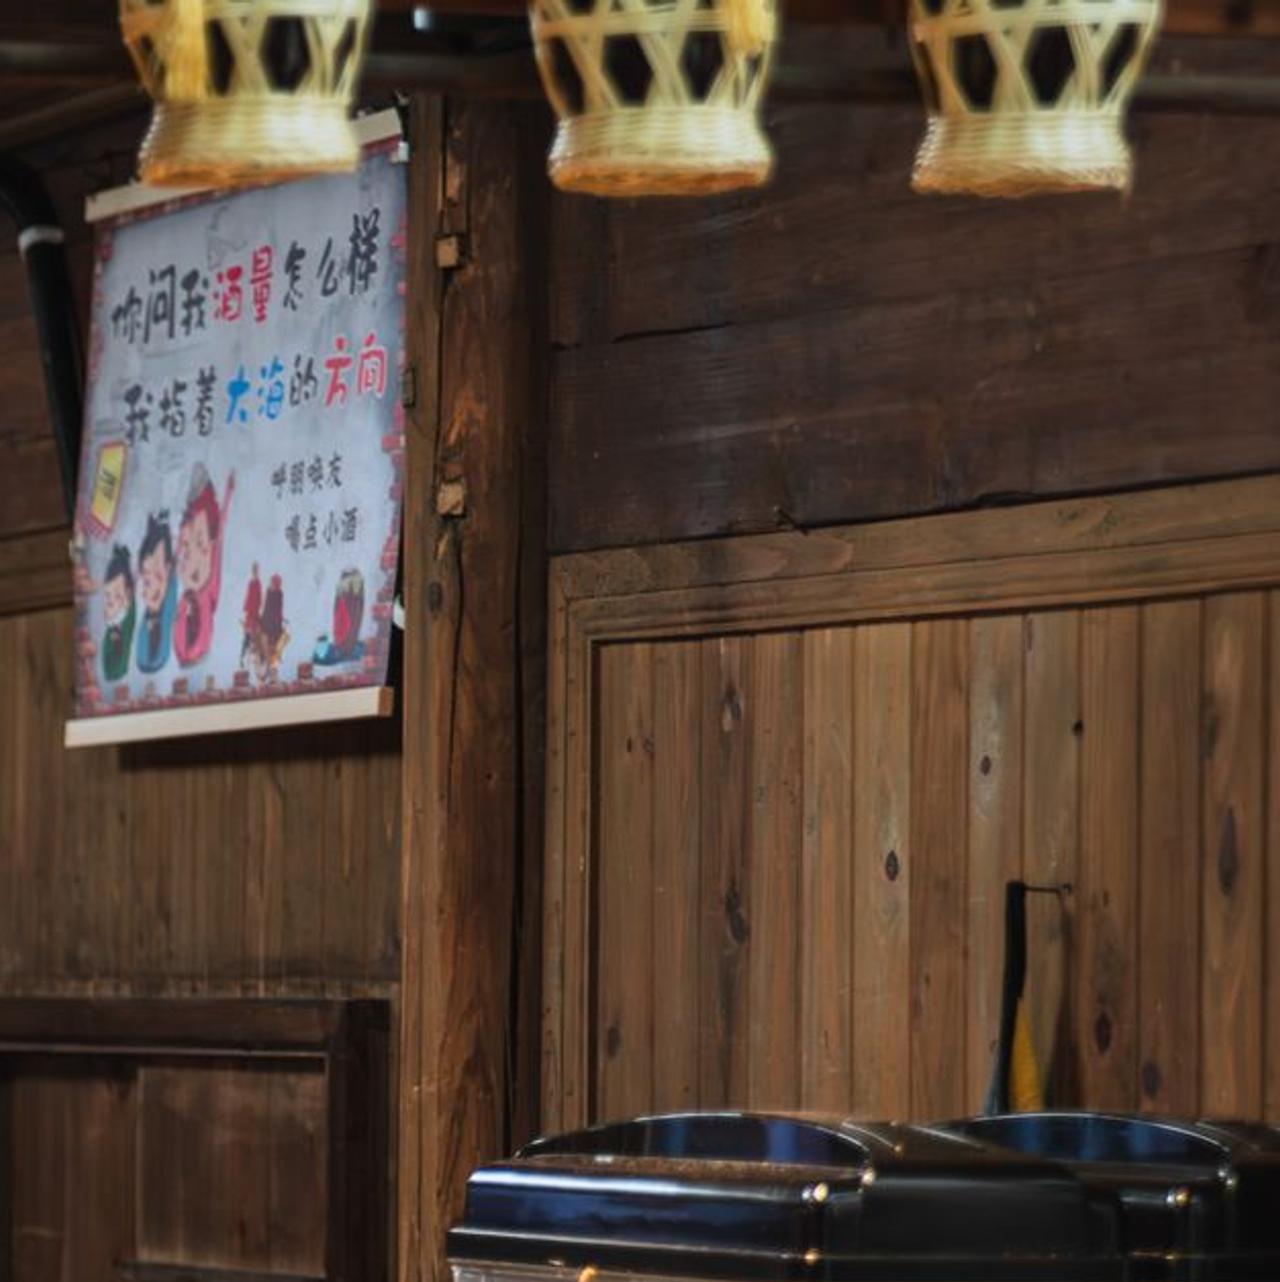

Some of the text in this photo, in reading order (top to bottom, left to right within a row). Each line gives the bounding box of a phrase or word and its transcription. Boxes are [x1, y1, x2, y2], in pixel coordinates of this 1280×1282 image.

[123, 331, 387, 446] 我指着大海的方向
